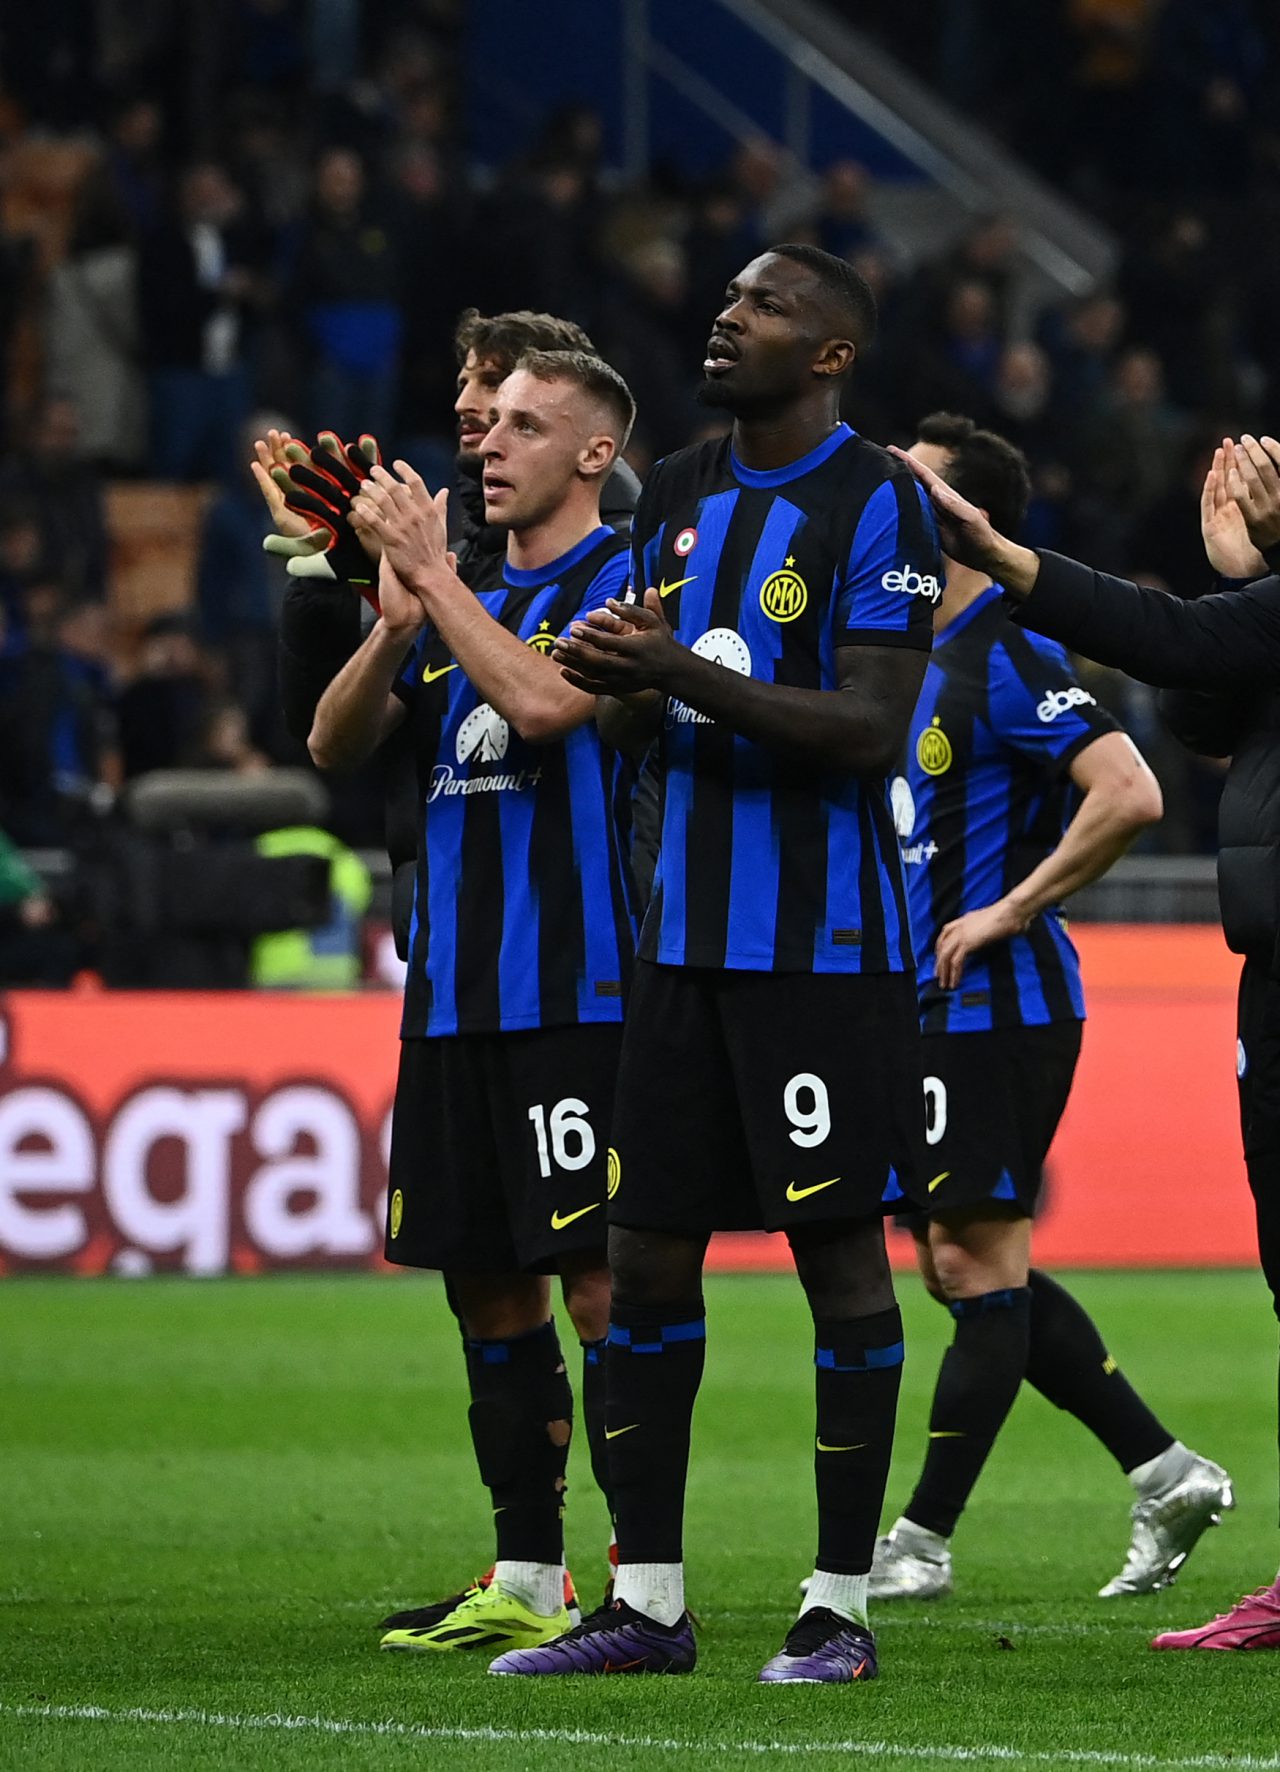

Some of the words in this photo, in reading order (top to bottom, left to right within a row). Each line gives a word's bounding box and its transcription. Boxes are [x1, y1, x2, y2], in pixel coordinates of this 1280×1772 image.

[881, 564, 942, 604] ebay
[528, 1097, 596, 1178] 16
[783, 1072, 831, 1148] 9
[0, 1085, 388, 1278] ega
